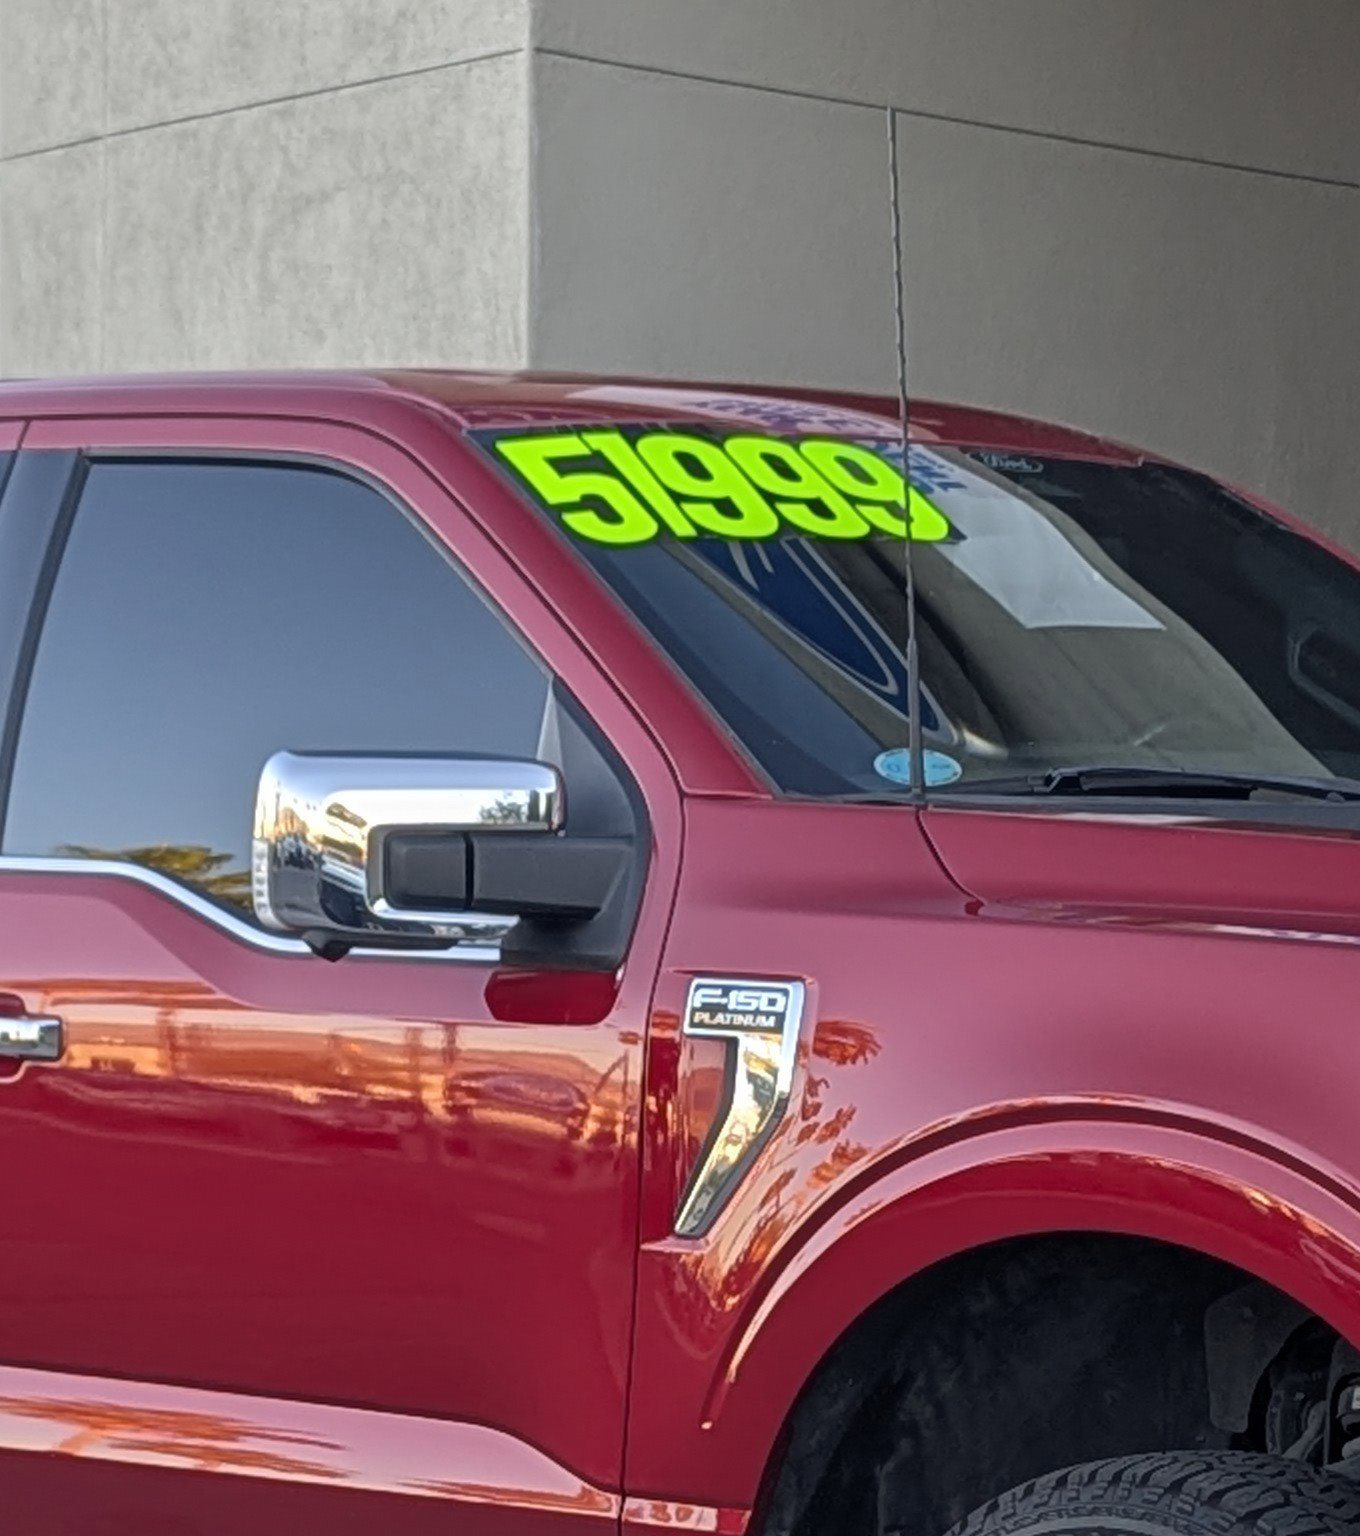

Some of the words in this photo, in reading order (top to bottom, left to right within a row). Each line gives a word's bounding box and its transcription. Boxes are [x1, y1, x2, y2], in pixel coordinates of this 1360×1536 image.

[494, 432, 949, 545] 51999
[693, 988, 787, 1013] F-150
[692, 1012, 777, 1028] PLATINUM
